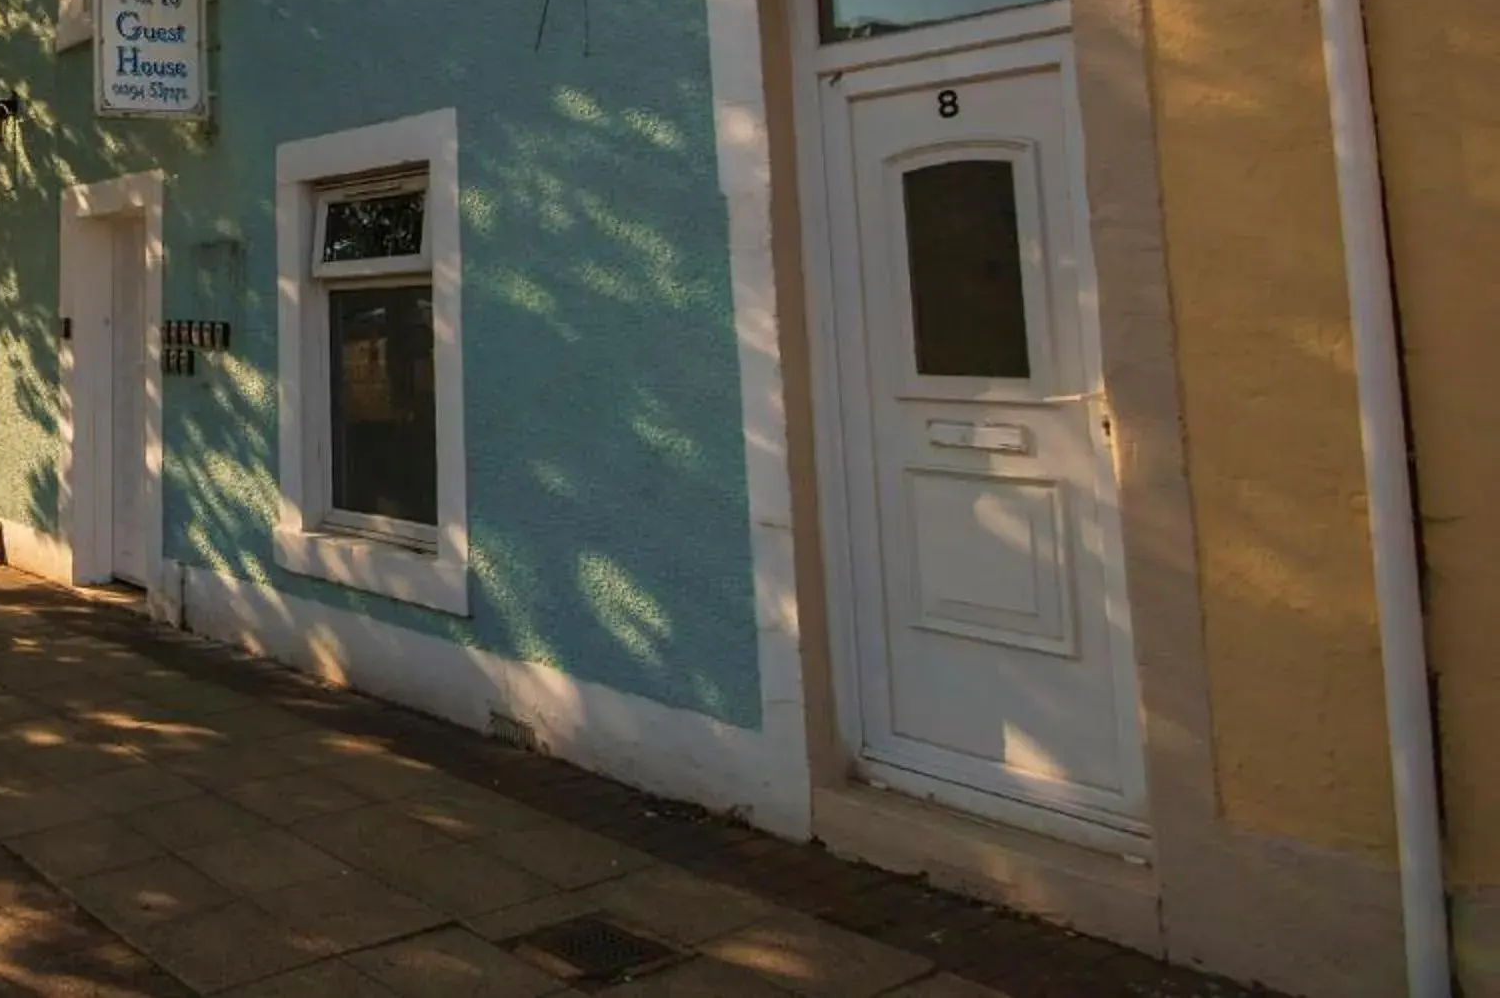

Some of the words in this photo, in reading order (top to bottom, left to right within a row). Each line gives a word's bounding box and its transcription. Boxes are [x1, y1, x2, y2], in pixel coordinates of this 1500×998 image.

[115, 10, 187, 43] Guest
[115, 45, 189, 79] House
[938, 89, 960, 119] 8
